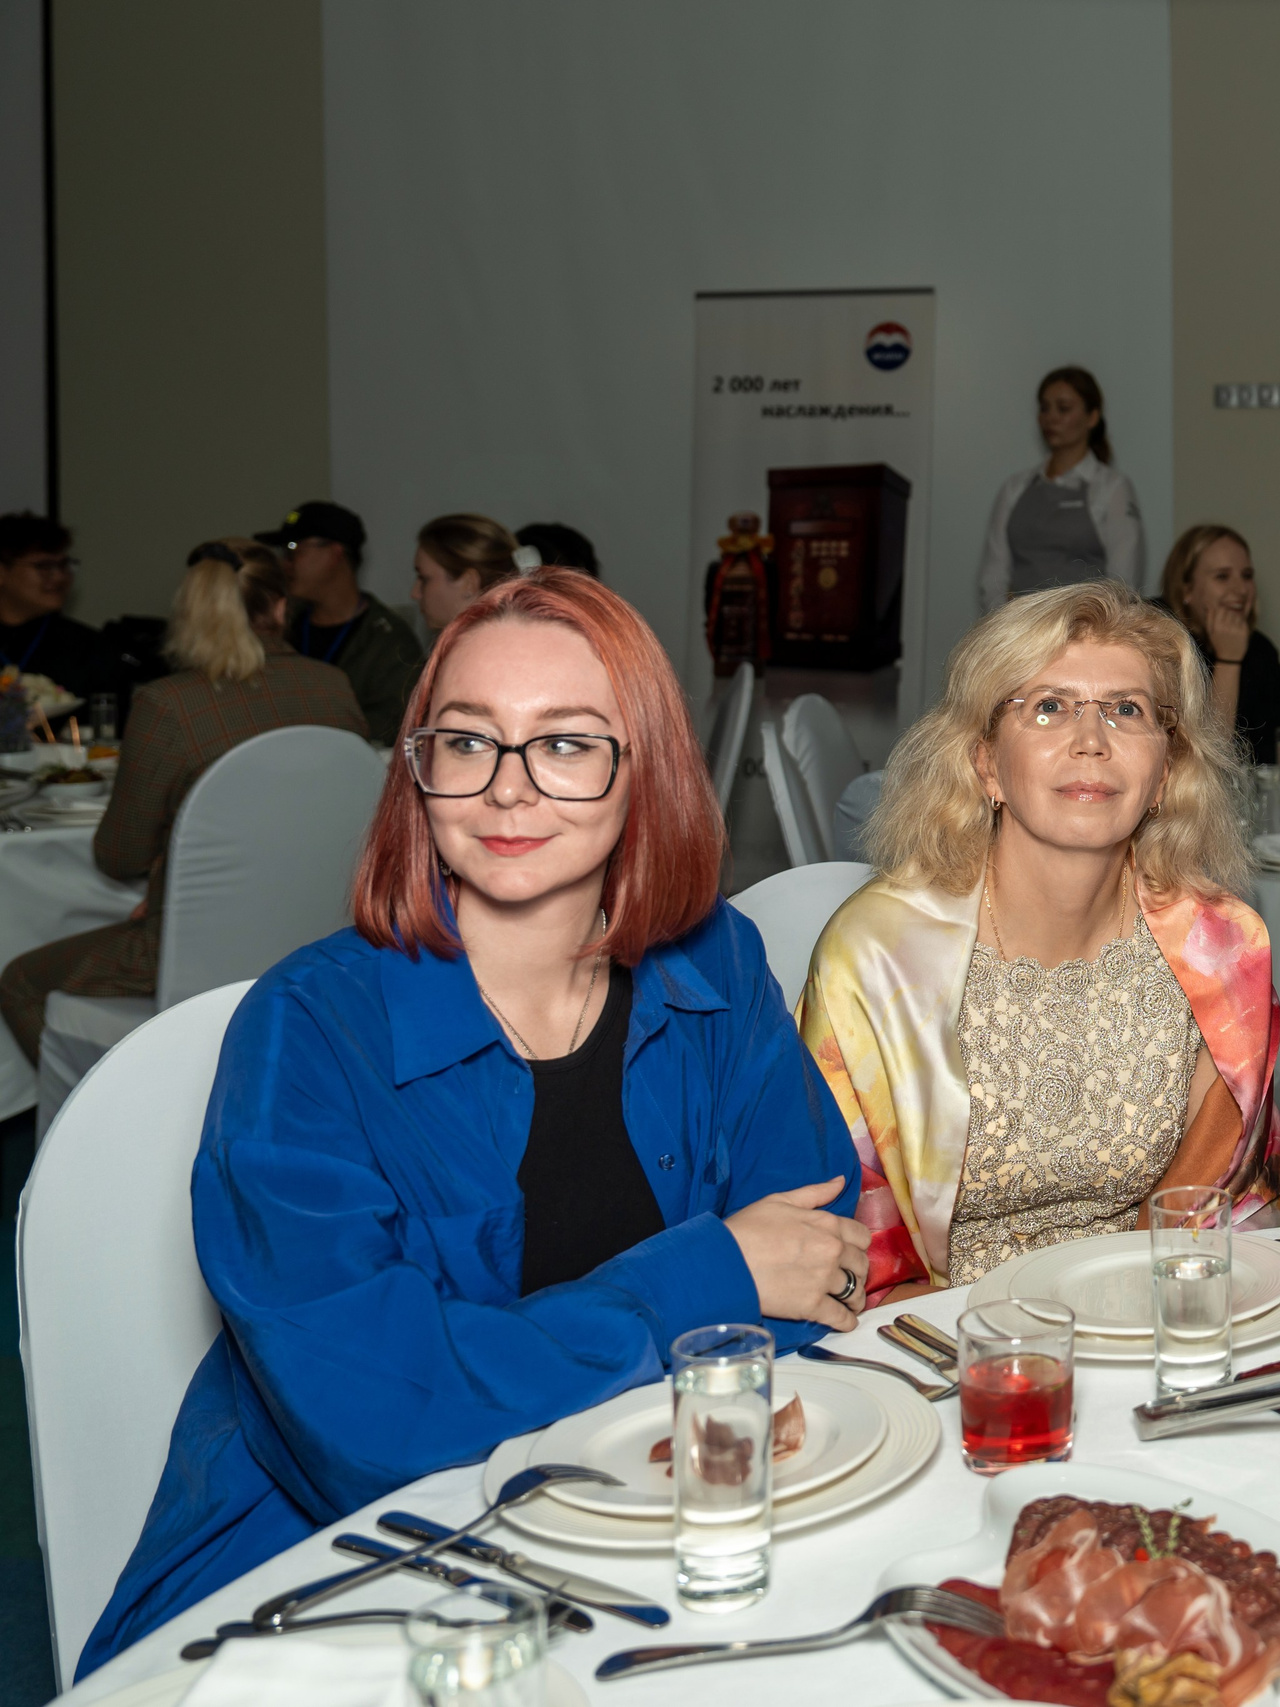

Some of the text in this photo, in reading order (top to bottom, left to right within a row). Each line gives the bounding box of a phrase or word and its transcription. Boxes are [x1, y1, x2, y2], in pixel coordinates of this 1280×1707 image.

[713, 376, 801, 393] 2 000 лет
